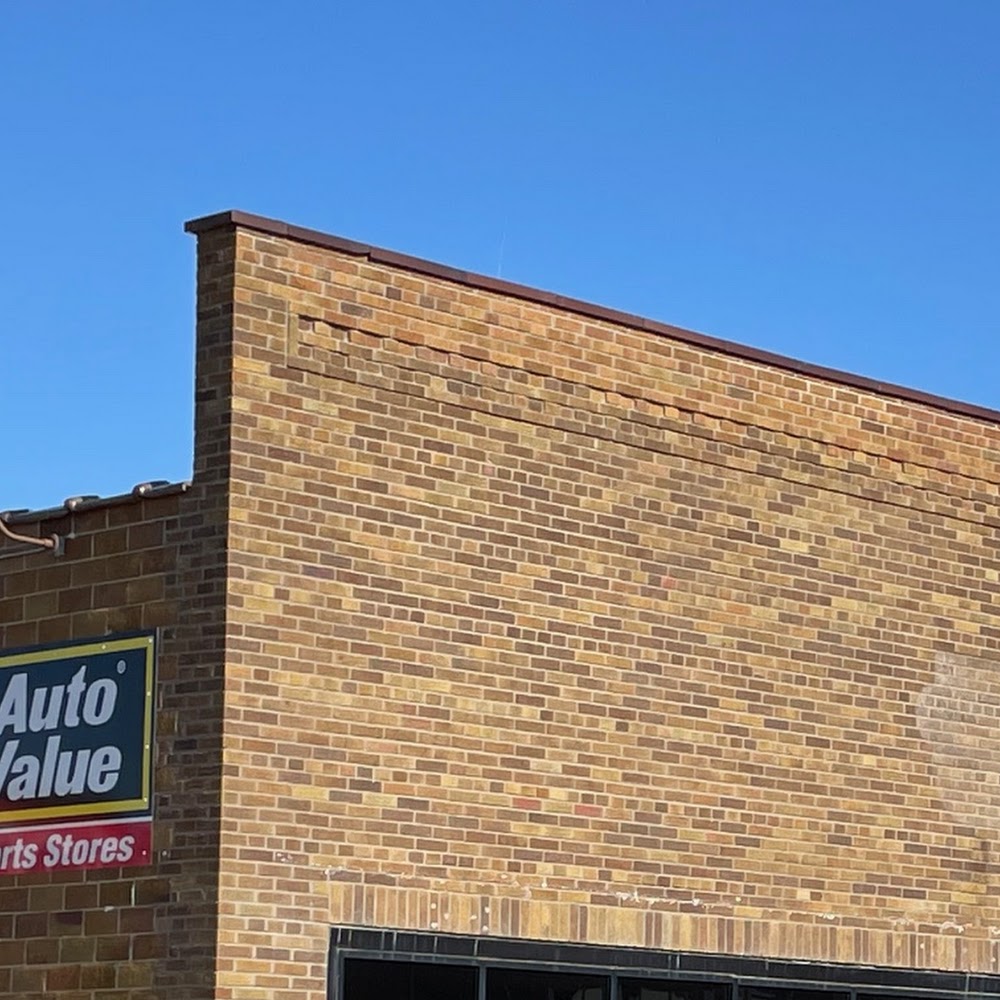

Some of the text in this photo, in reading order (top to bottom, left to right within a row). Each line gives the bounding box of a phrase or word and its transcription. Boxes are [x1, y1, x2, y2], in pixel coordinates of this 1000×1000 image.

[0, 664, 118, 734] Auto
[0, 834, 135, 870] rts Stores
